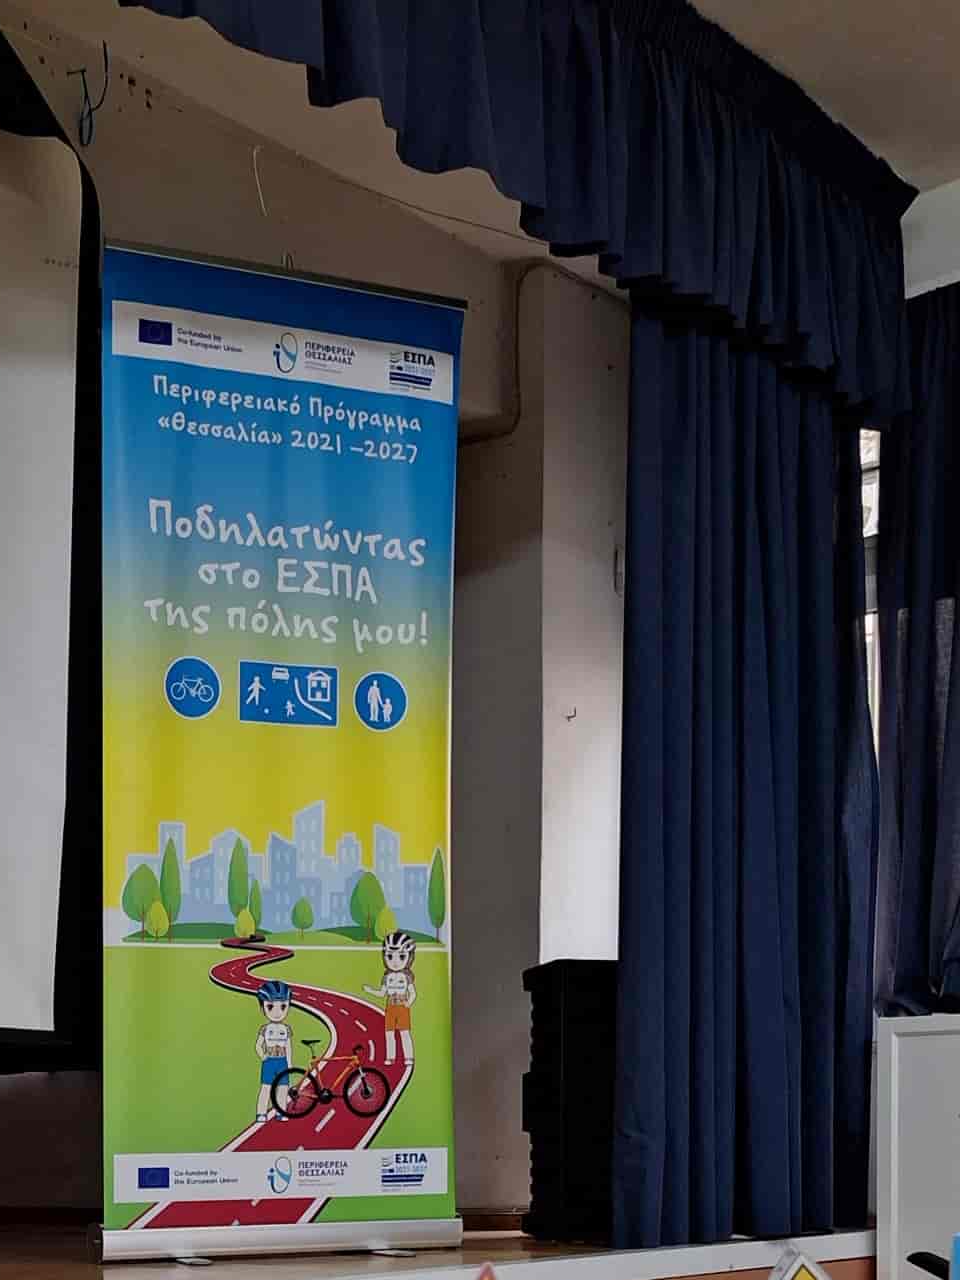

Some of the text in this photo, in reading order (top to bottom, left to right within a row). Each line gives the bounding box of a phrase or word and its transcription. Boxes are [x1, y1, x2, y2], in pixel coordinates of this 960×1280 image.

[404, 351, 435, 367] ΕΣΠΑ
[152, 375, 422, 433] Περιφερειακό Πρόγραμμα
[157, 412, 282, 446] «Θεσσαλία»
[291, 430, 342, 454] 2021
[148, 498, 426, 567] Ποδηλατώντας
[197, 557, 377, 604] στο ΕΣΠΑ
[143, 598, 428, 653] της πόλης μου!
[395, 1153, 428, 1164] ΕΣΠΑ
